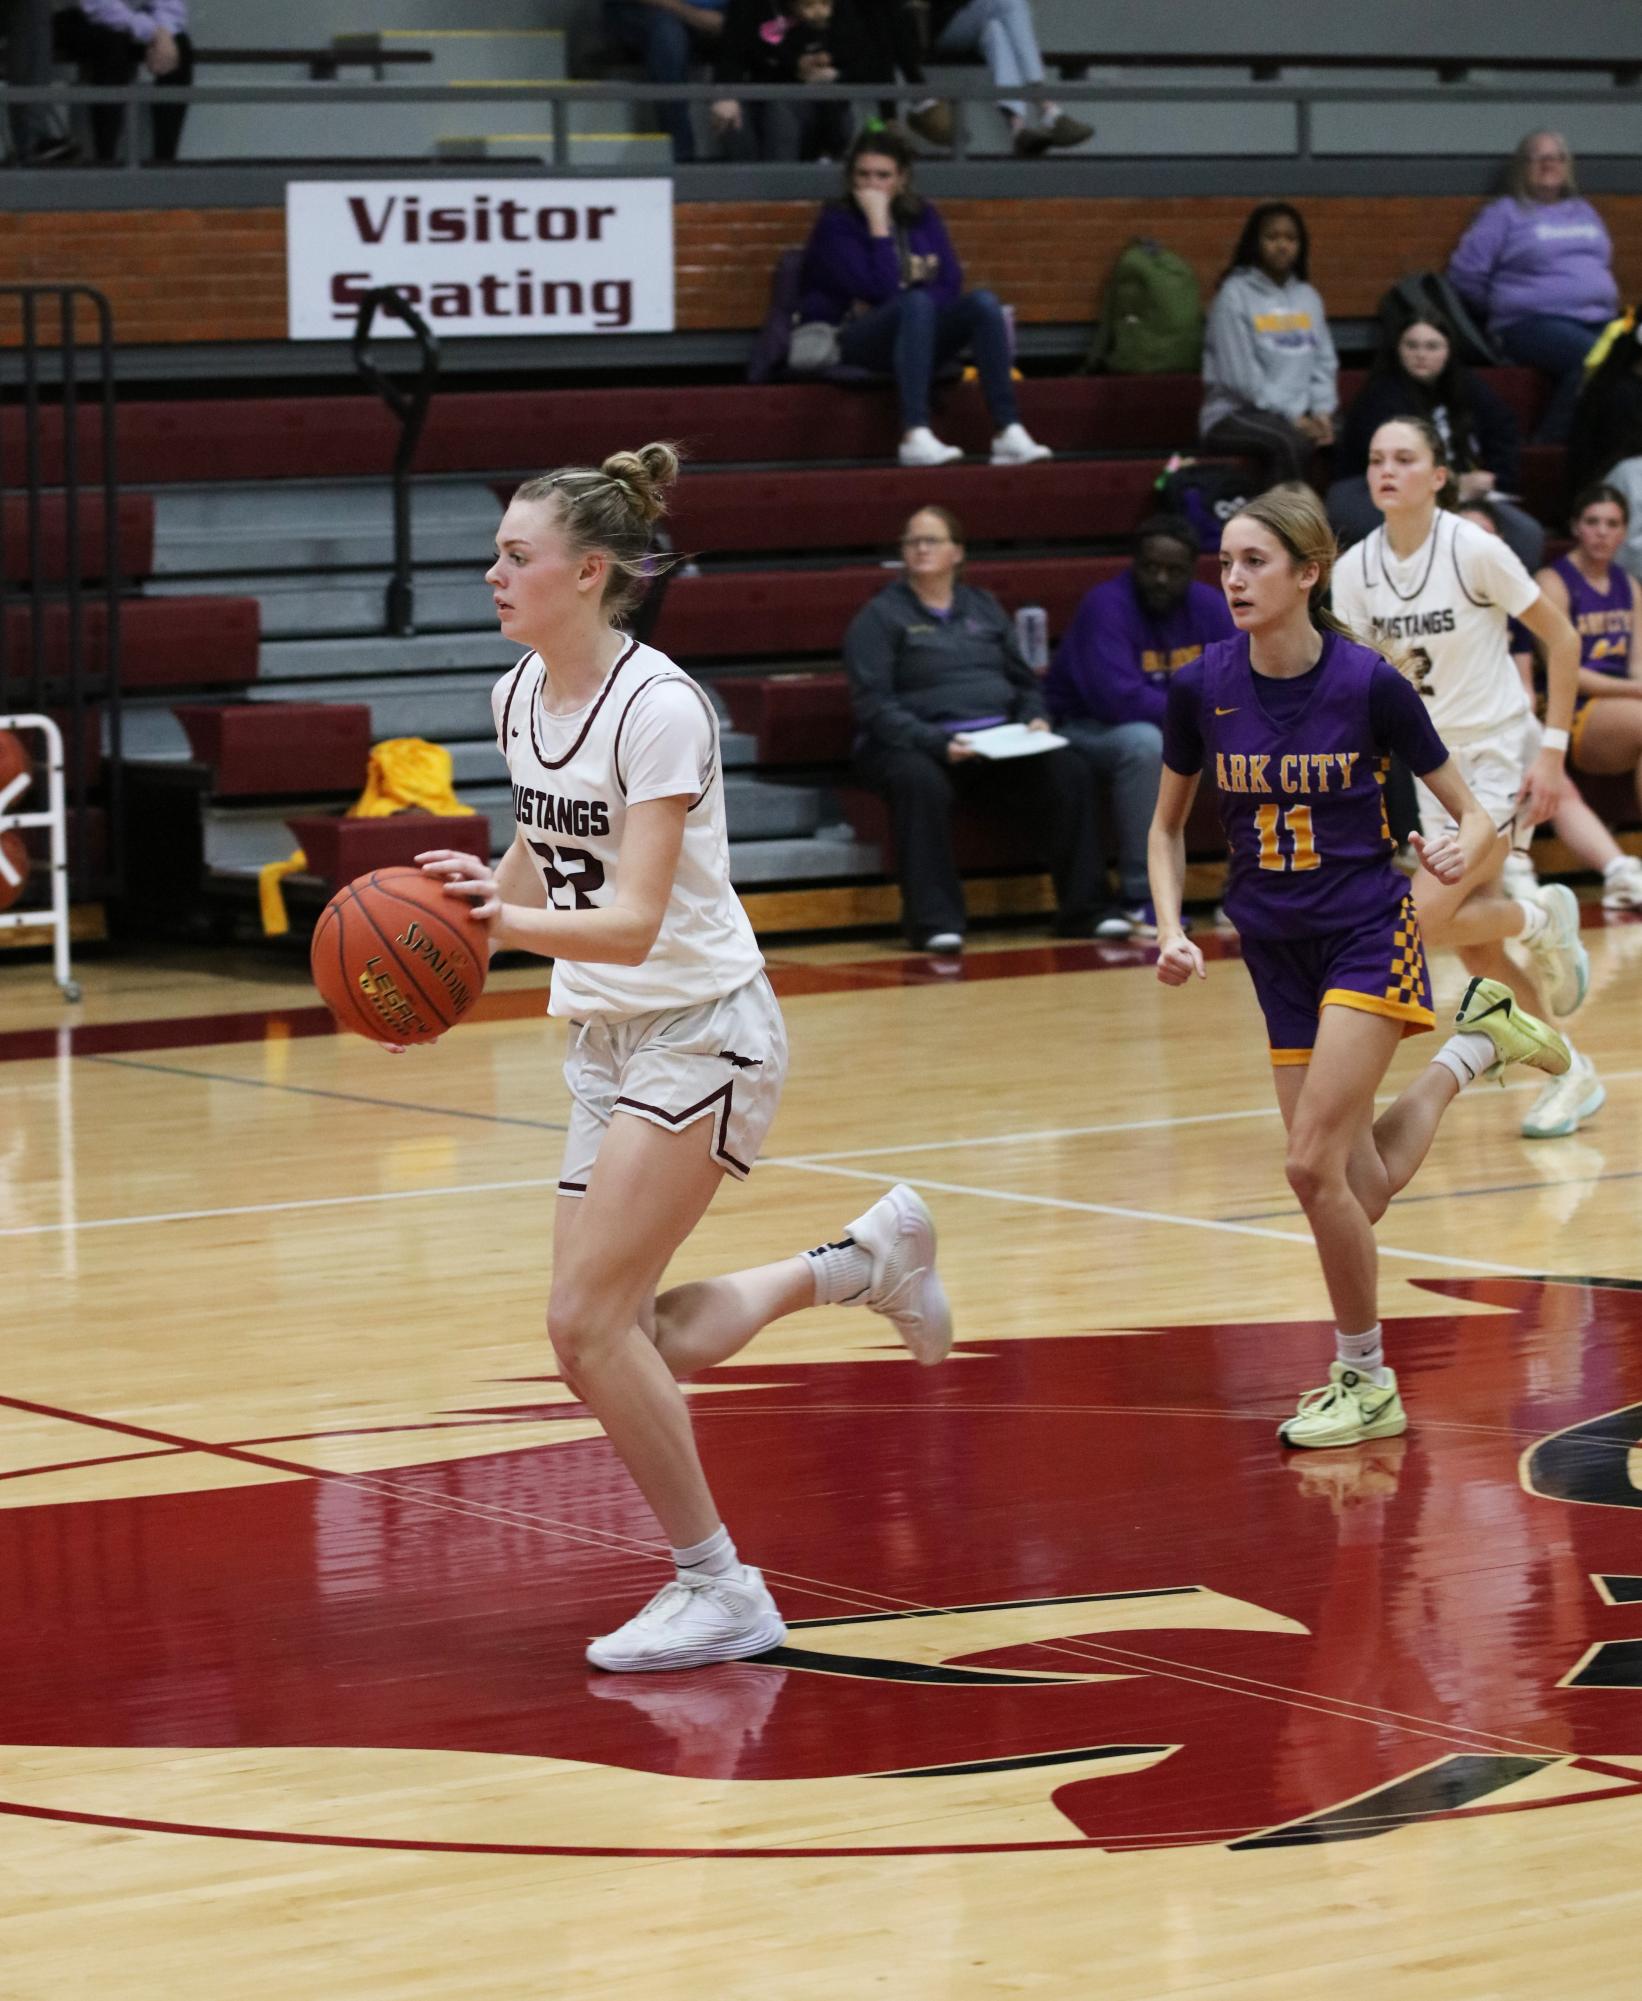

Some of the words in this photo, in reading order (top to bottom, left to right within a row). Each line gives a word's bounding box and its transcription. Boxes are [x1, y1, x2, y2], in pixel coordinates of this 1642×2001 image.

[346, 195, 617, 244] Visitor
[1216, 752, 1272, 793] ARK
[1279, 752, 1360, 793] CITY
[1253, 804, 1321, 872] 11
